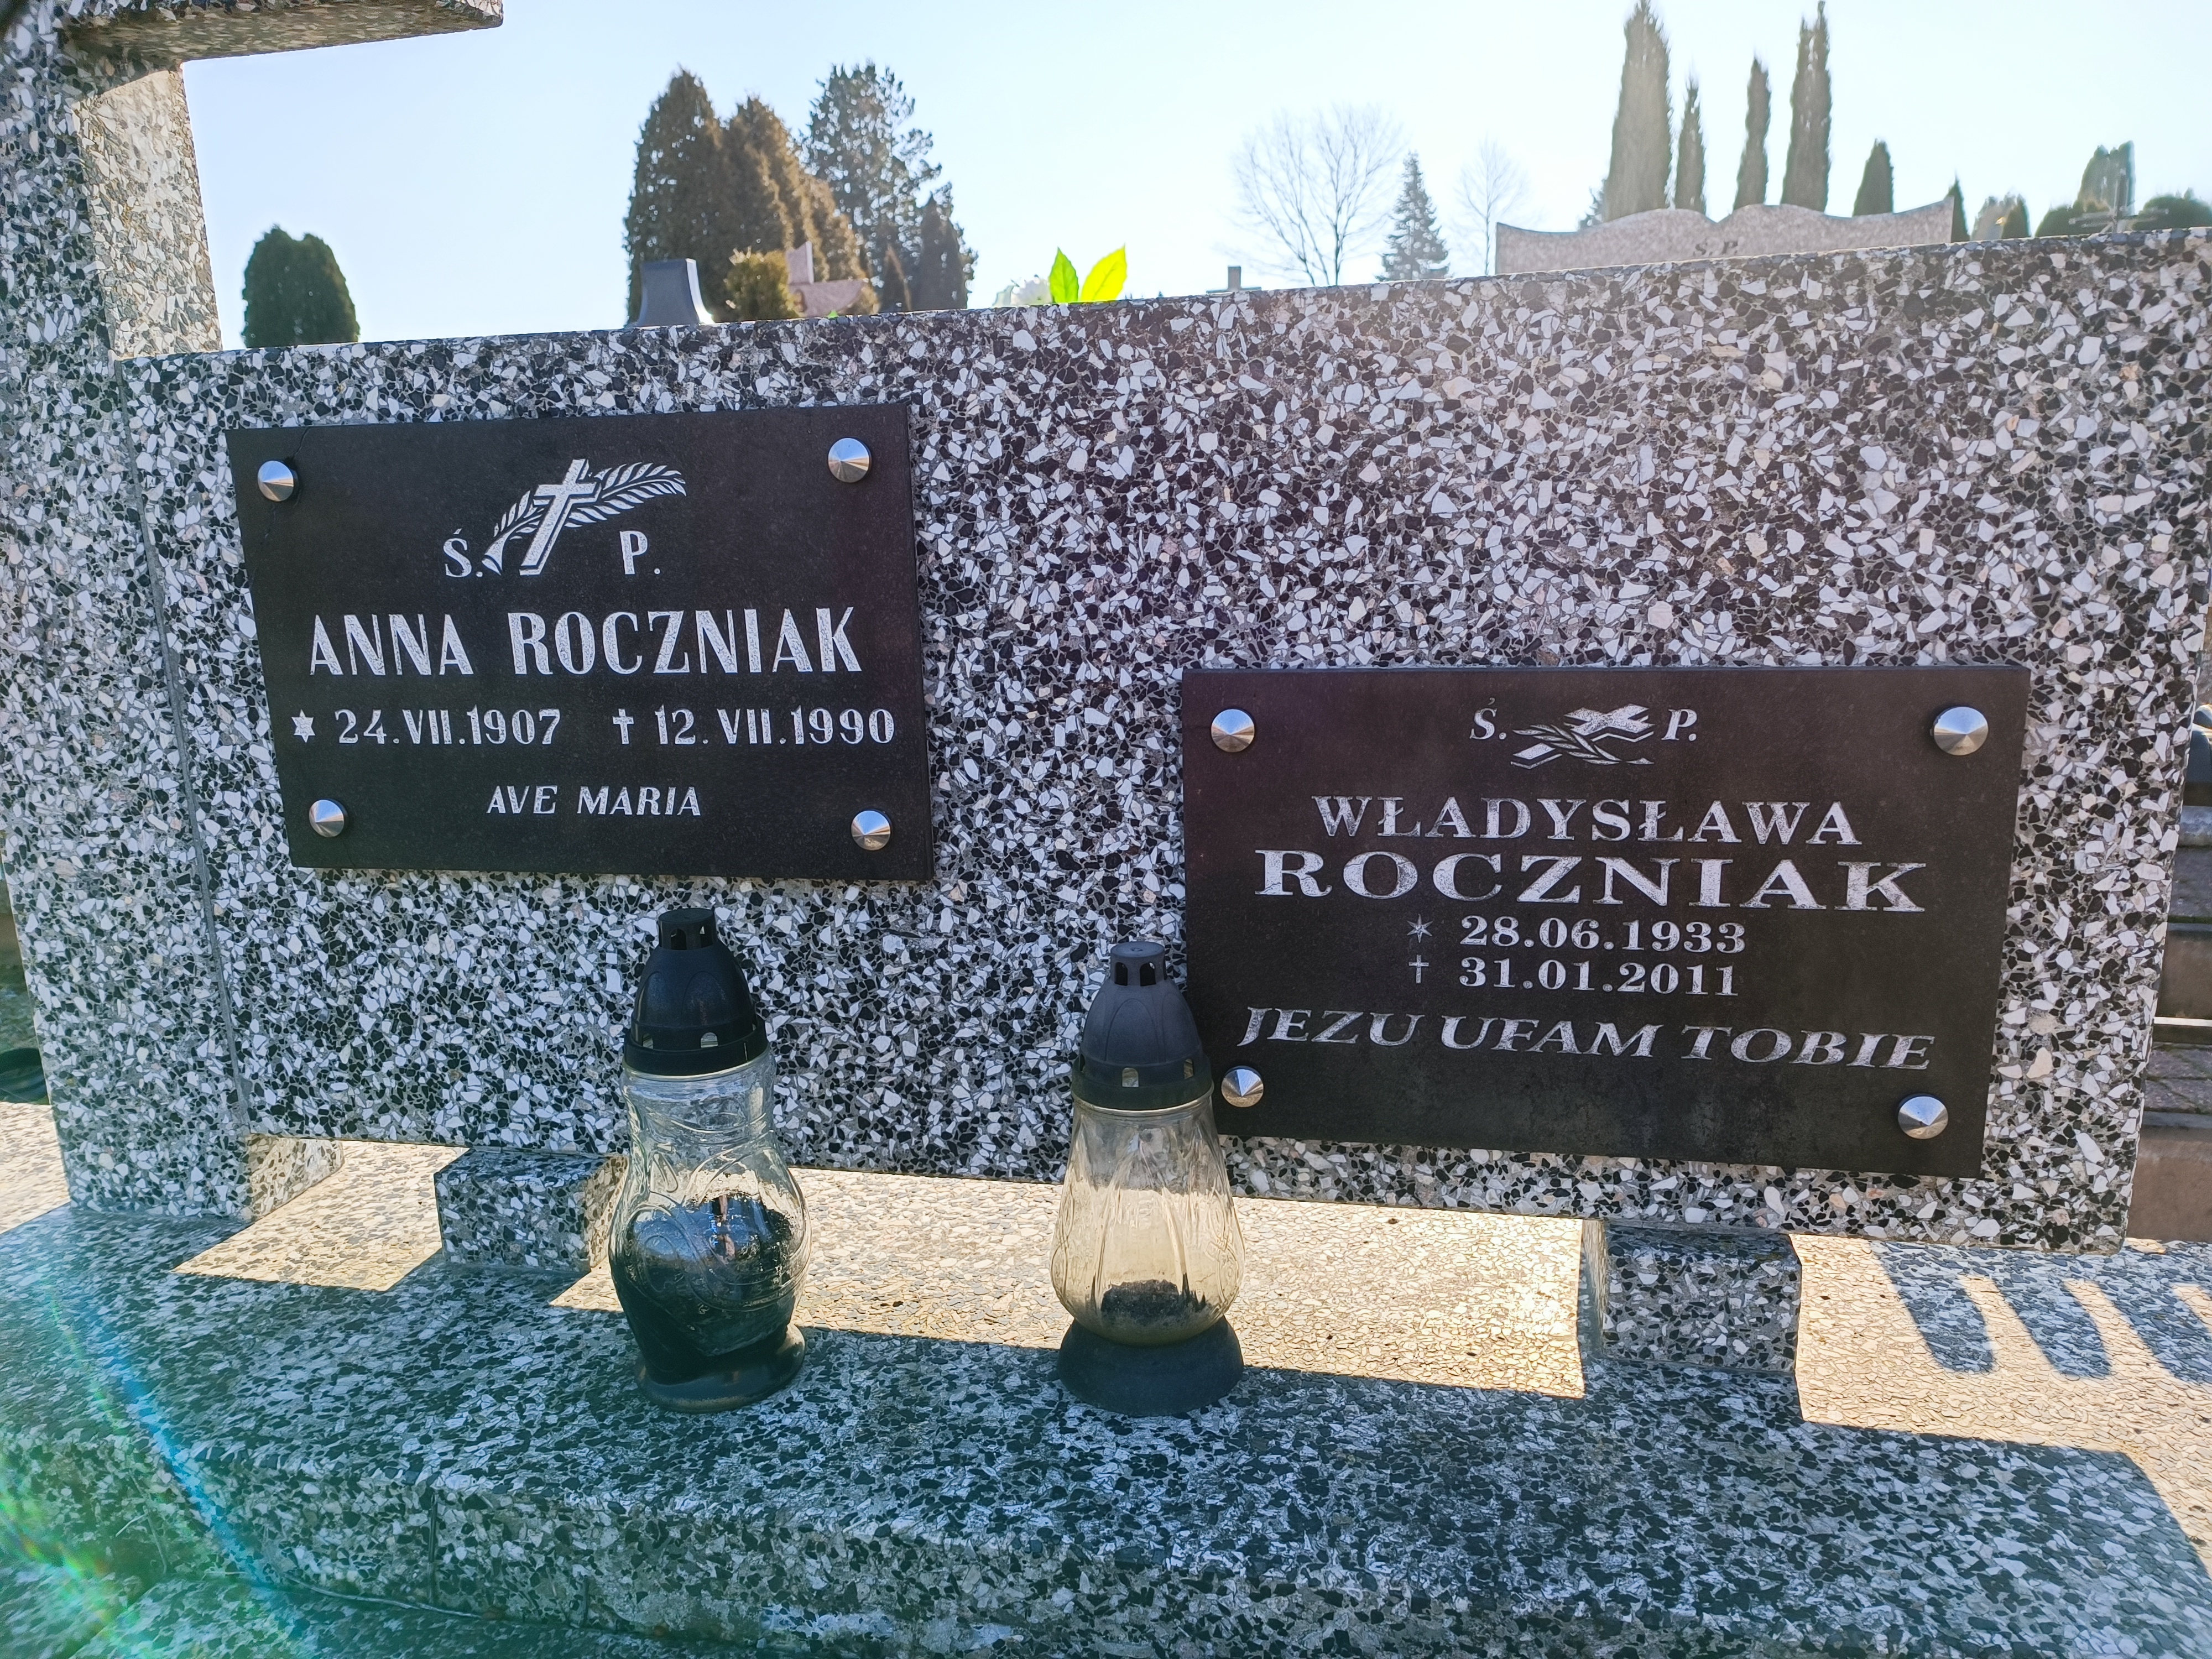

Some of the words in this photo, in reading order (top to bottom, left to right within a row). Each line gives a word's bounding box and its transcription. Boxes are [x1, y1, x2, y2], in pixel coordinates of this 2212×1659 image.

[443, 529, 483, 578] Ś.
[619, 530, 661, 575] P.
[310, 613, 474, 676] ANNA
[508, 606, 862, 675] ROCZNIAK
[334, 705, 561, 745] 24.VII.1907
[1469, 697, 1507, 740] Ś.
[1661, 708, 1698, 742] P.
[486, 785, 559, 815] AVE
[576, 785, 701, 816] MARIA
[1311, 795, 1863, 846] WŁADYSŁAWA
[1254, 849, 1927, 912] ROCZNIAK
[1459, 915, 1745, 954] 28.06.1933
[1459, 956, 1739, 997] 31.01.2011
[1237, 1006, 1425, 1047] JEZU
[1441, 1015, 1663, 1058] UFAM
[1681, 1025, 1936, 1070] TOBIE
